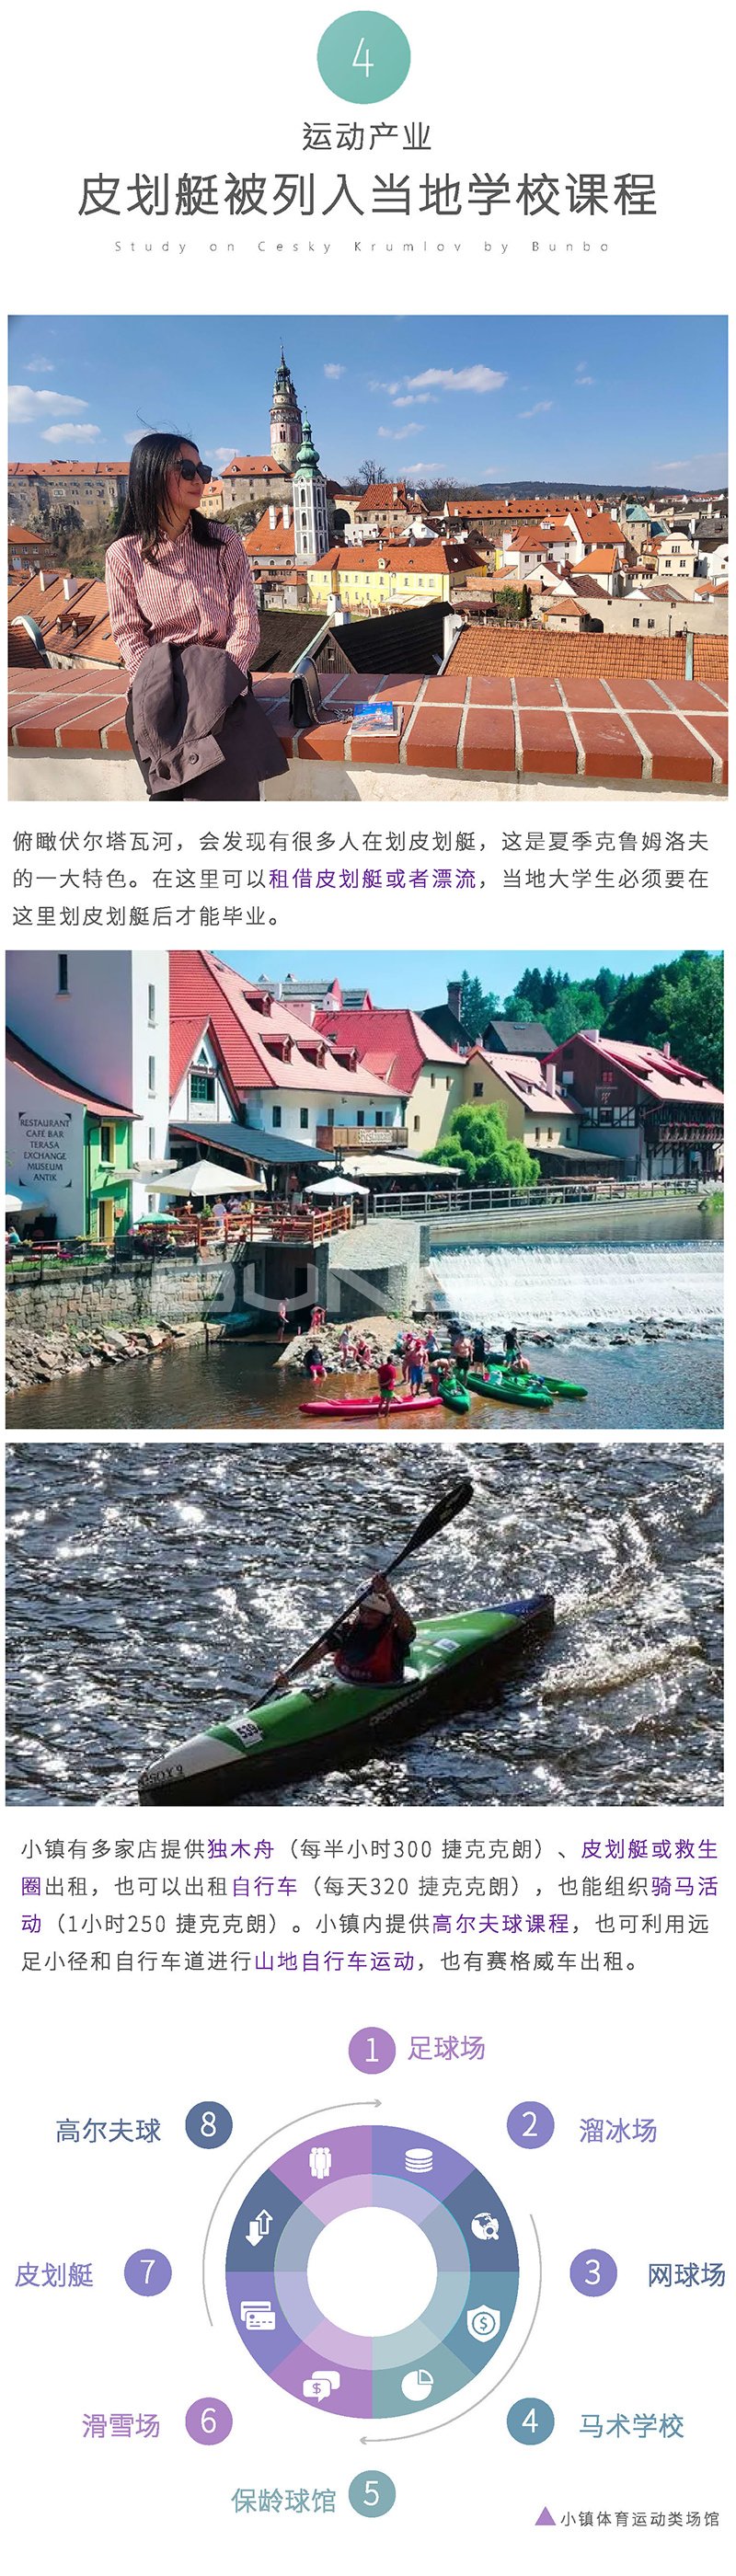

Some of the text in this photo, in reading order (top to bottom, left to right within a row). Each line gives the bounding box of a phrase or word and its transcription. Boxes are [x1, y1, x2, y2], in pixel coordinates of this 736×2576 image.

[20, 1119, 70, 1127] RESTAURANT
[48, 1130, 64, 1138] BAR
[29, 1141, 60, 1149] TERASA
[23, 1152, 67, 1160] EXCHANGE
[27, 1163, 63, 1171] MUSEUM
[33, 1173, 57, 1181] ANTIK
